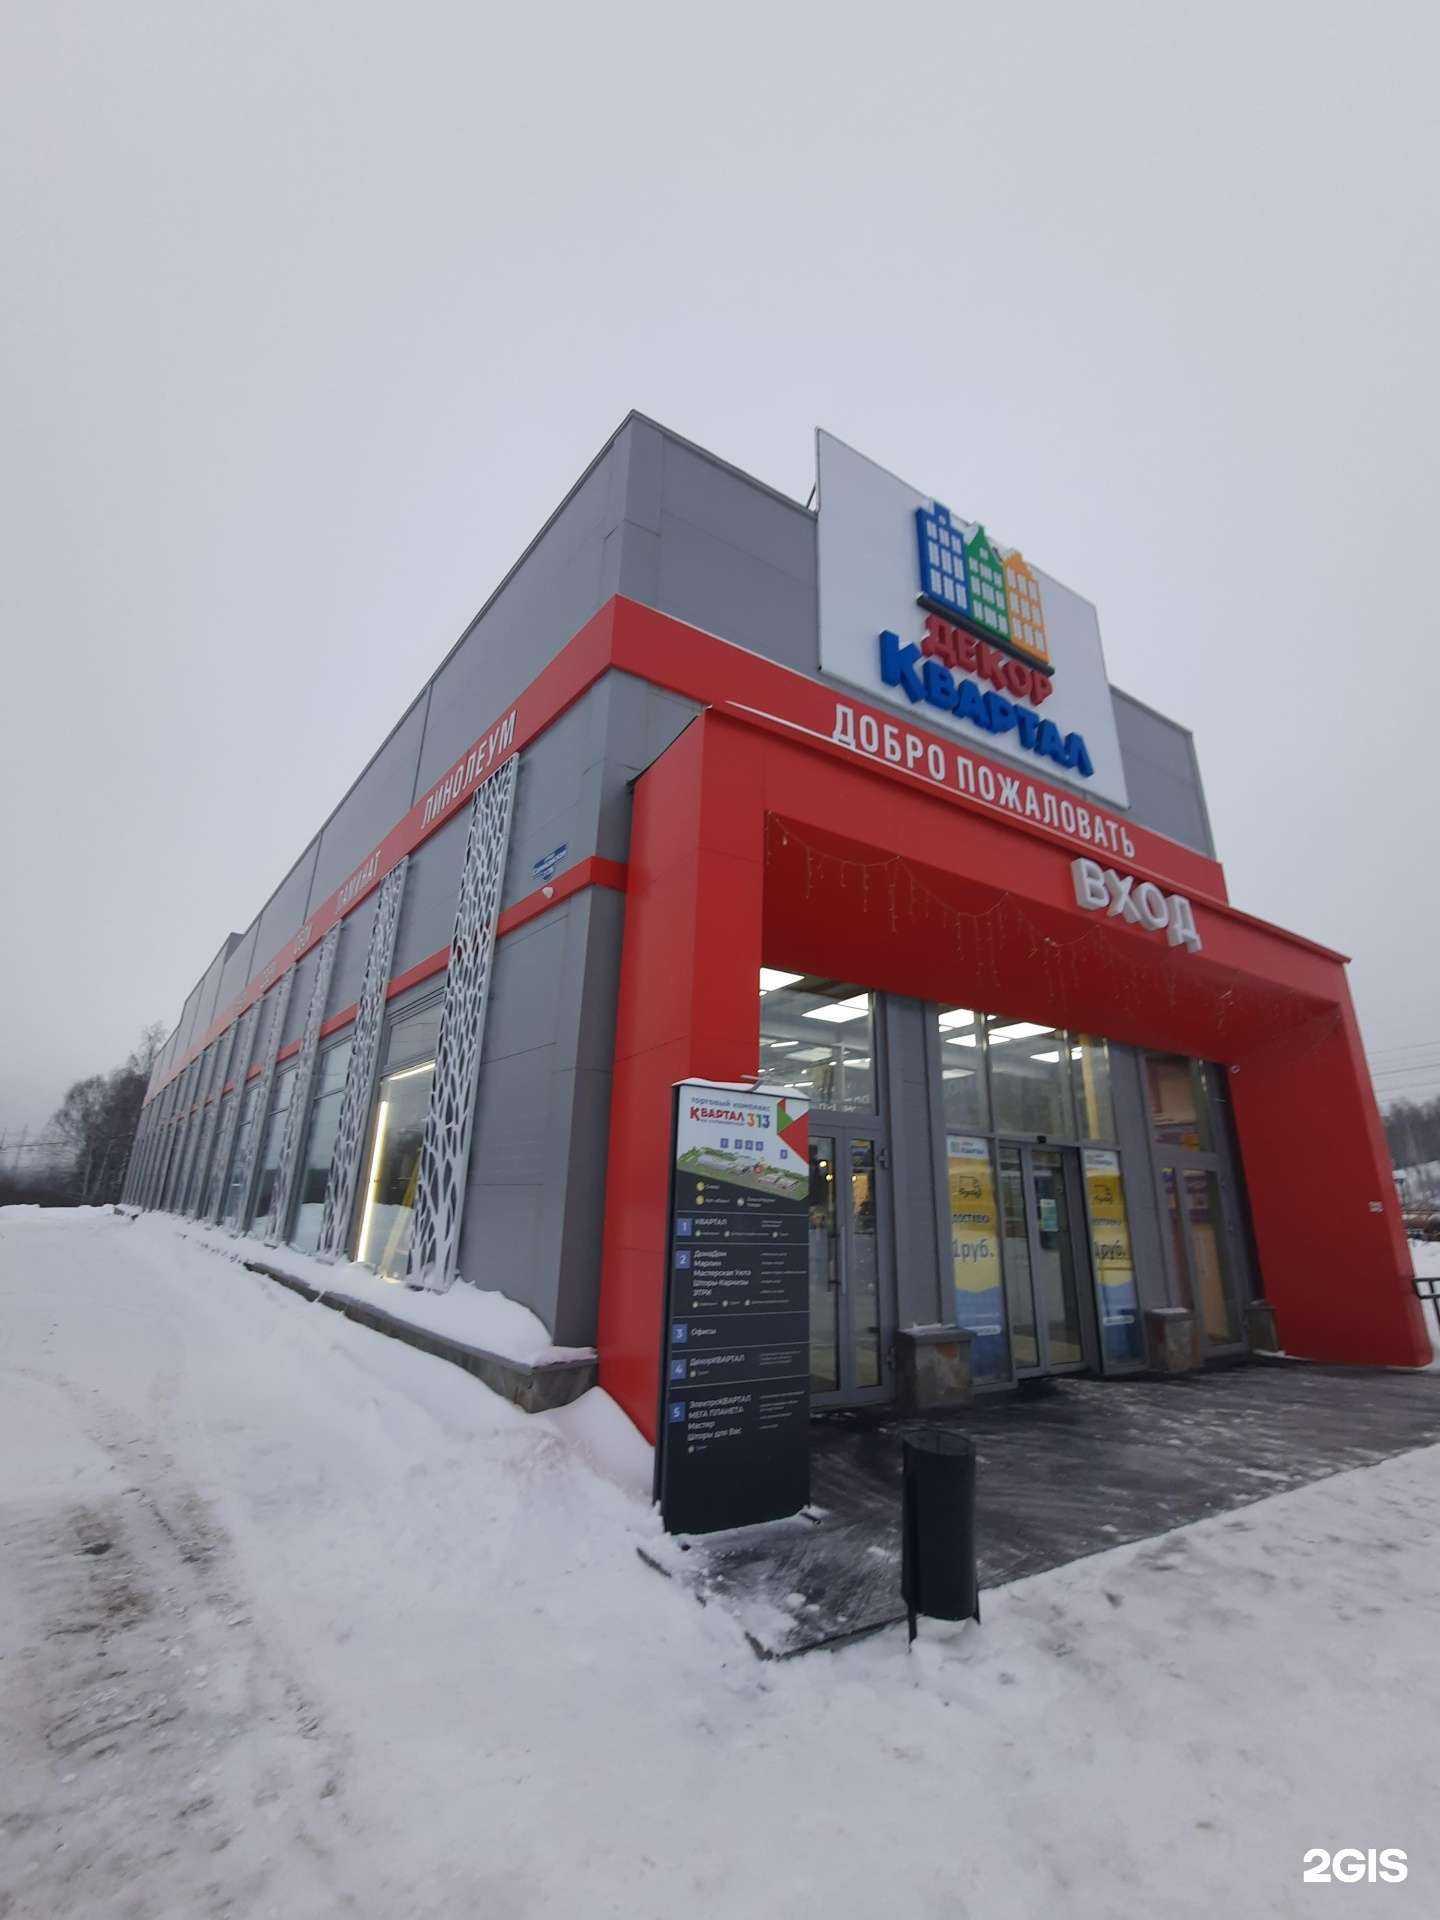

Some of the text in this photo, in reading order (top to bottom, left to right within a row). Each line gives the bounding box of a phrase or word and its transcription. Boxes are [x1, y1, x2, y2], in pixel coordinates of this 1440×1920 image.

[879, 629, 1095, 778] КВАРТАЛ
[920, 612, 1055, 706] ДЕКОР
[420, 709, 517, 829] ЛИНОЛЕУМ
[832, 703, 1136, 859] ДОБРО ПОЖАЛОВАТЬ
[1070, 856, 1203, 954] ВХОД
[690, 1106, 744, 1121] КВАРТАЛ
[747, 1112, 770, 1128] 313
